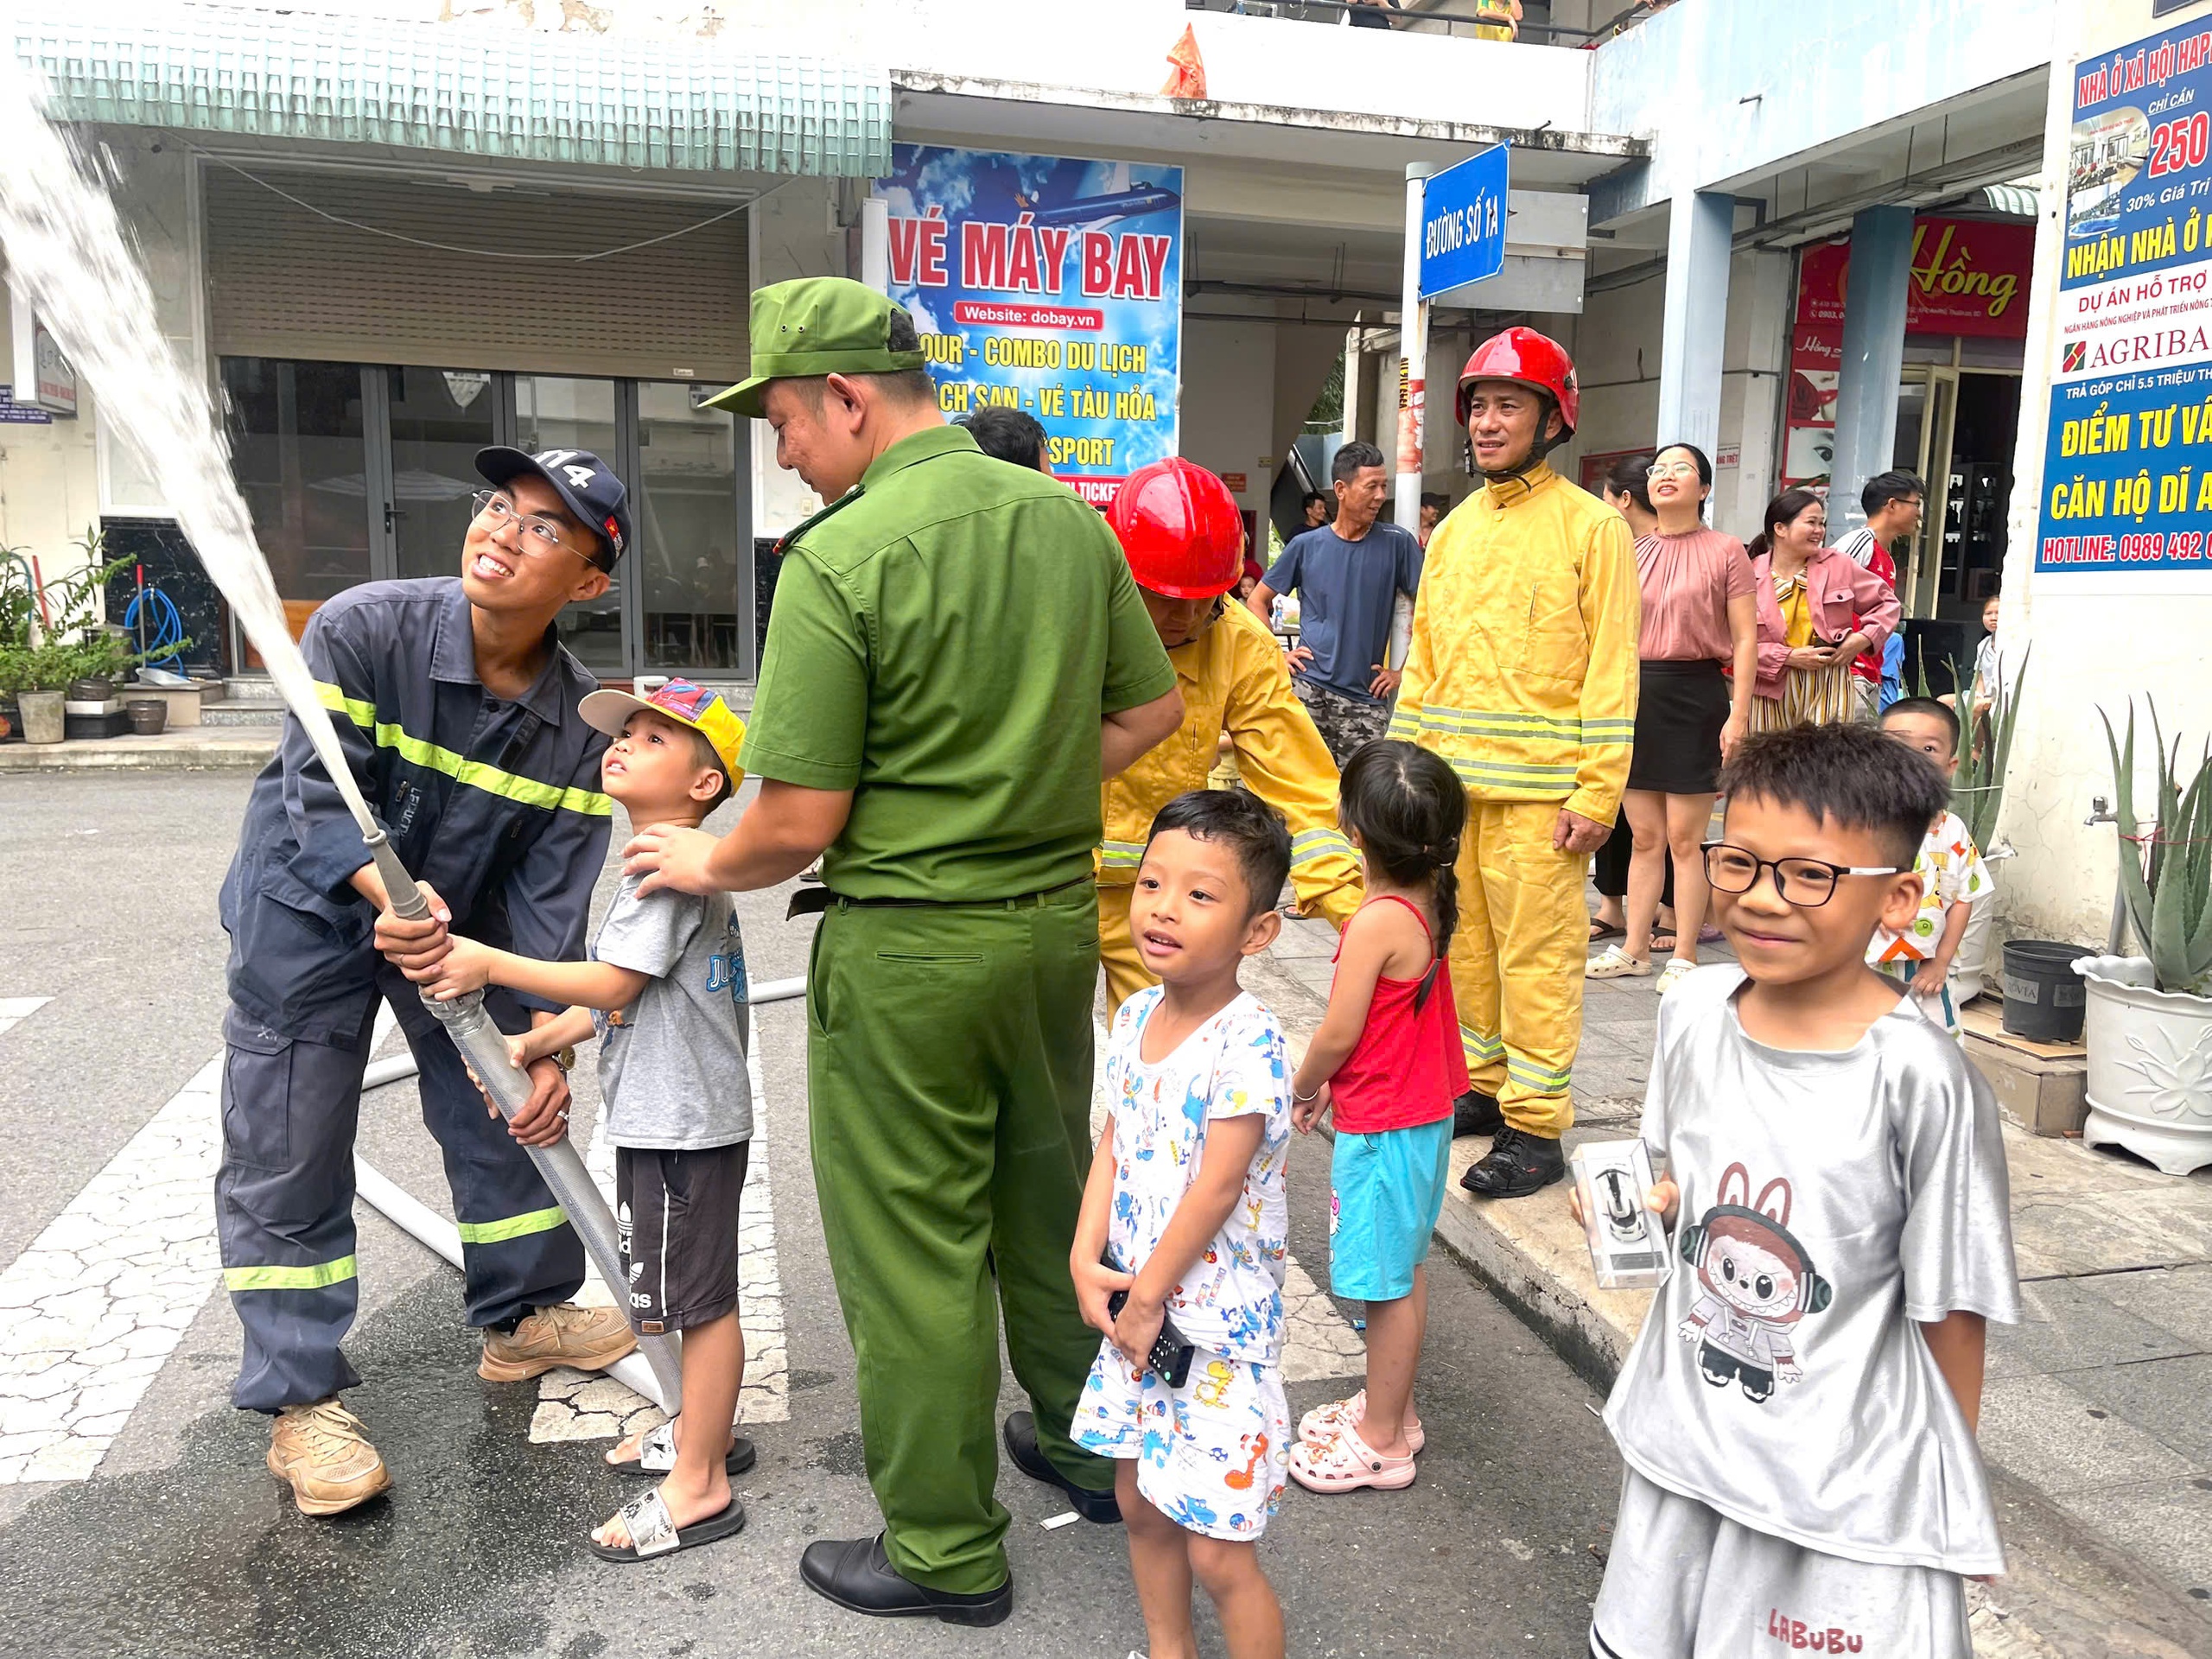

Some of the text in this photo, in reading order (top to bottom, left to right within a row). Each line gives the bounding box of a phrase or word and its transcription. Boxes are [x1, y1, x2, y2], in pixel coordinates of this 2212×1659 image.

[2077, 31, 2212, 108] NHÀ Ở XÃ HỘI HAP
[2148, 111, 2209, 179] 250
[2126, 177, 2211, 213] 30% Giá Trị
[1426, 206, 1464, 260] ĐƯỜNG
[1465, 187, 1485, 245] SỐ
[2067, 232, 2126, 279] NHẬN
[2131, 216, 2177, 264] NHÀ
[2183, 207, 2202, 252] Ở
[887, 206, 1172, 300] VÉ MÁY BAY
[1909, 225, 2018, 318] Hồng
[2078, 270, 2207, 314] DỰ ÁN HỖ TRỢ
[963, 306, 1096, 328] Website: dobay.vn
[918, 333, 963, 364] OUR
[984, 337, 1060, 369] COMBO
[1066, 342, 1095, 371] DU
[1101, 343, 1147, 379] LỊCH
[2089, 325, 2212, 369] AGRIBA
[1039, 383, 1065, 417] VÉ
[1071, 385, 1109, 420] TÀU
[1116, 383, 1157, 421] HỎA
[2066, 383, 2087, 400] TRẢ
[2089, 379, 2113, 397] GÓP
[2137, 375, 2154, 390] 5.5
[1045, 436, 1116, 466] SPORT
[2061, 400, 2131, 458] ĐIỂM
[2139, 403, 2177, 450] TƯ
[534, 449, 596, 489] 114
[2050, 474, 2107, 520] CĂN
[2113, 468, 2152, 524] HỘ
[2158, 465, 2192, 515] DĨ
[2042, 533, 2116, 564] HOTLINE:
[2119, 531, 2165, 562] 0989
[2166, 531, 2203, 561] 492
[1768, 1607, 1864, 1655] LABUBU
